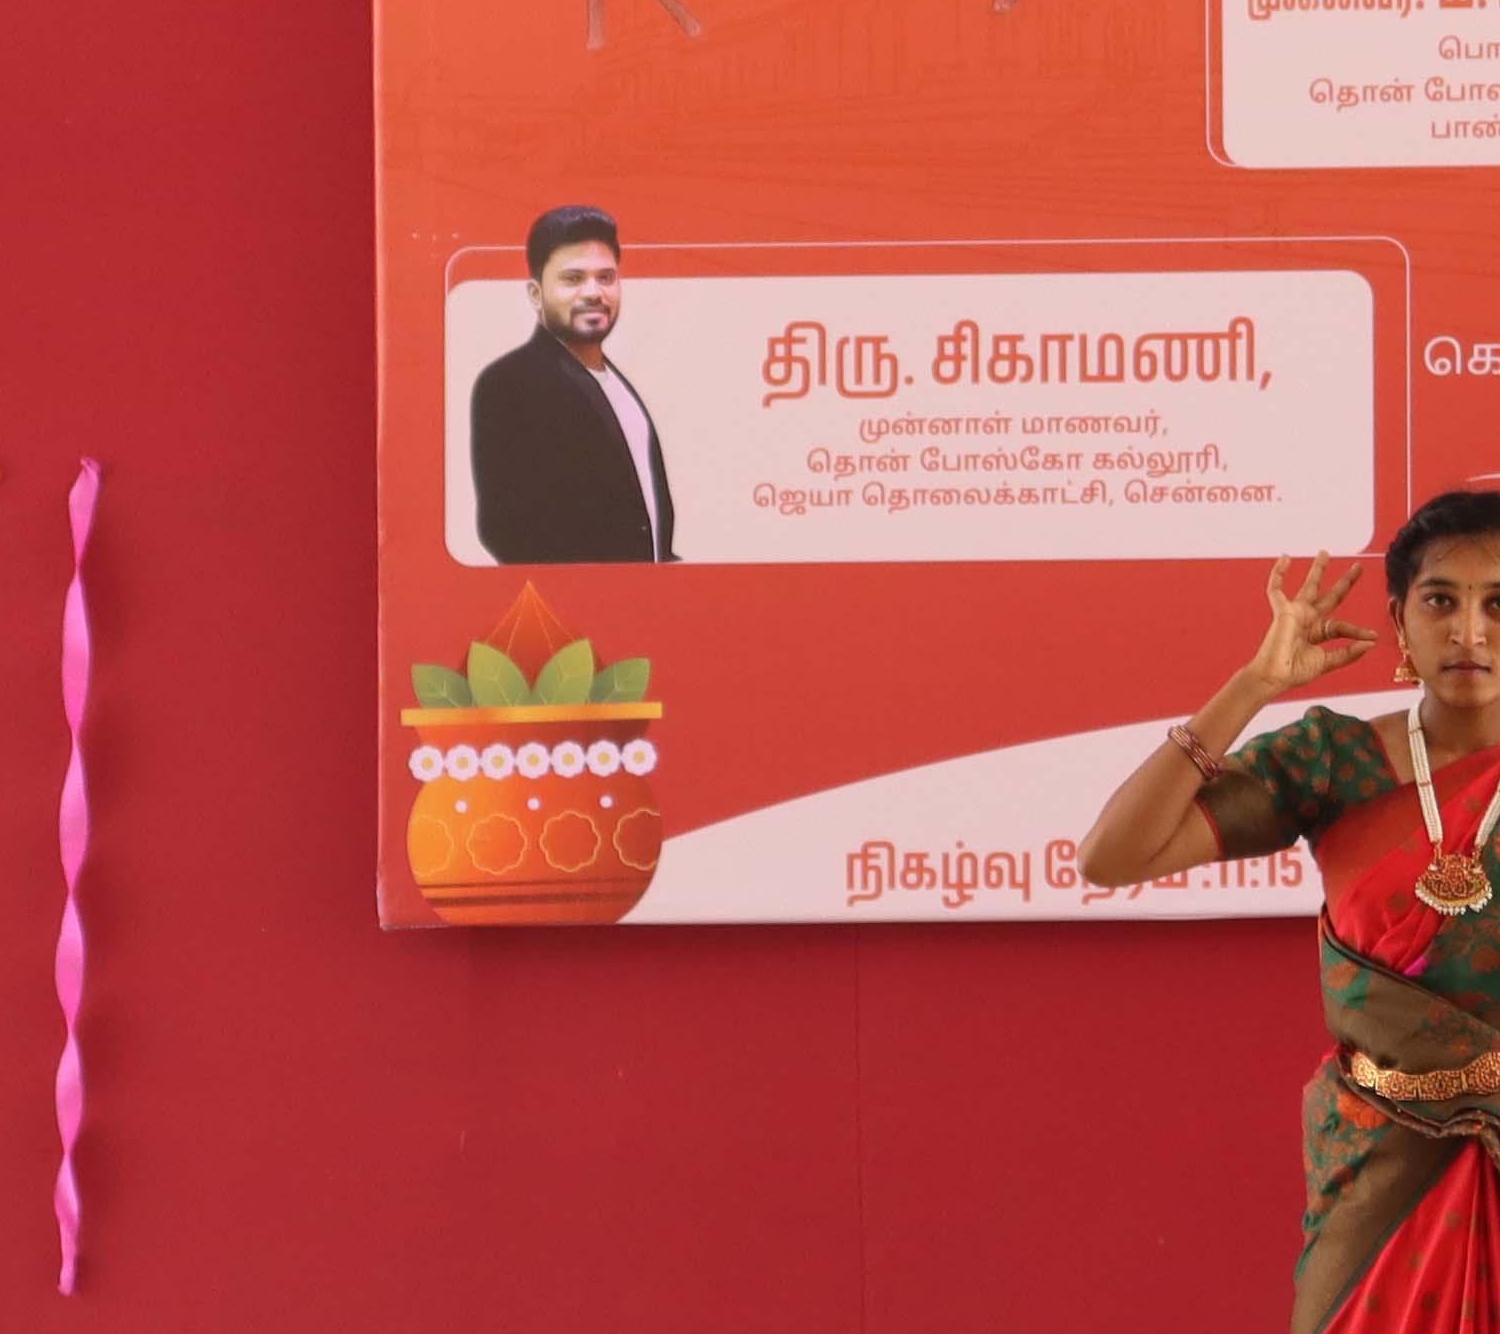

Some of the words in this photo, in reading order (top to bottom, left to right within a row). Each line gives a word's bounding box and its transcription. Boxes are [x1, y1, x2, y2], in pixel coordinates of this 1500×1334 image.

[1309, 78, 1414, 111] தொன்
[762, 321, 914, 407] திரு.
[932, 316, 1271, 390] சிகாமணி,
[859, 411, 1012, 444] முன்னாள்
[1022, 409, 1167, 437] மாணவர்,
[807, 447, 911, 479] தொன்
[920, 445, 1083, 472] போஸ்கோ
[1092, 443, 1227, 479] கல்லூரி,
[753, 483, 853, 515] ஜெயா
[862, 479, 1113, 514] தொலைக்காட்சி,
[1124, 476, 1282, 504] சென்னை.
[847, 841, 1031, 909] நிகழ்வு
